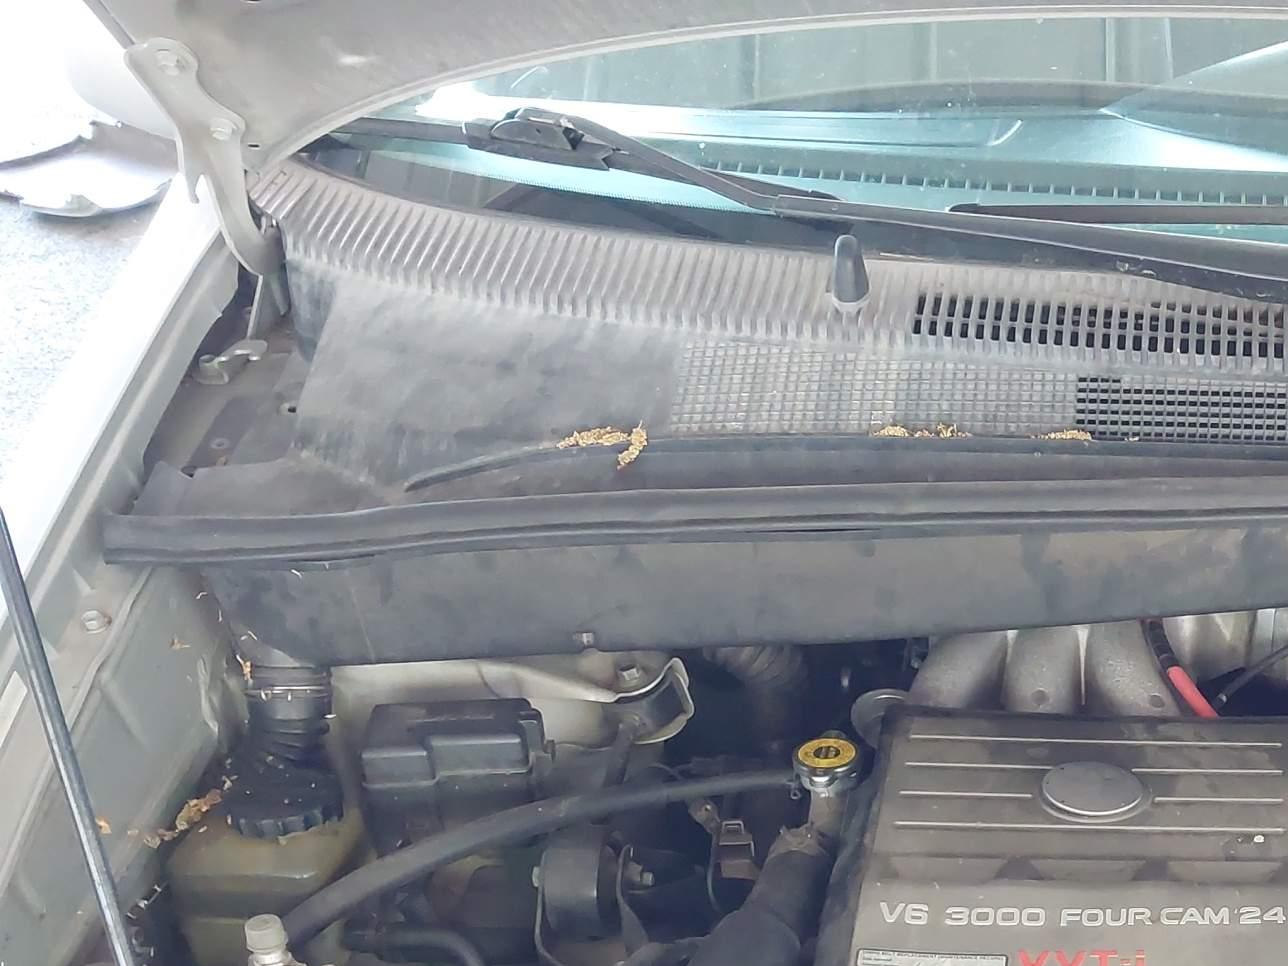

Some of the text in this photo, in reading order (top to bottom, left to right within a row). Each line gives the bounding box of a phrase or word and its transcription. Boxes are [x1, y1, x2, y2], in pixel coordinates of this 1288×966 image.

[879, 901, 929, 926] V6
[944, 906, 1046, 927] 3000
[1059, 906, 1153, 927] FOUR
[1159, 906, 1230, 926] CAM
